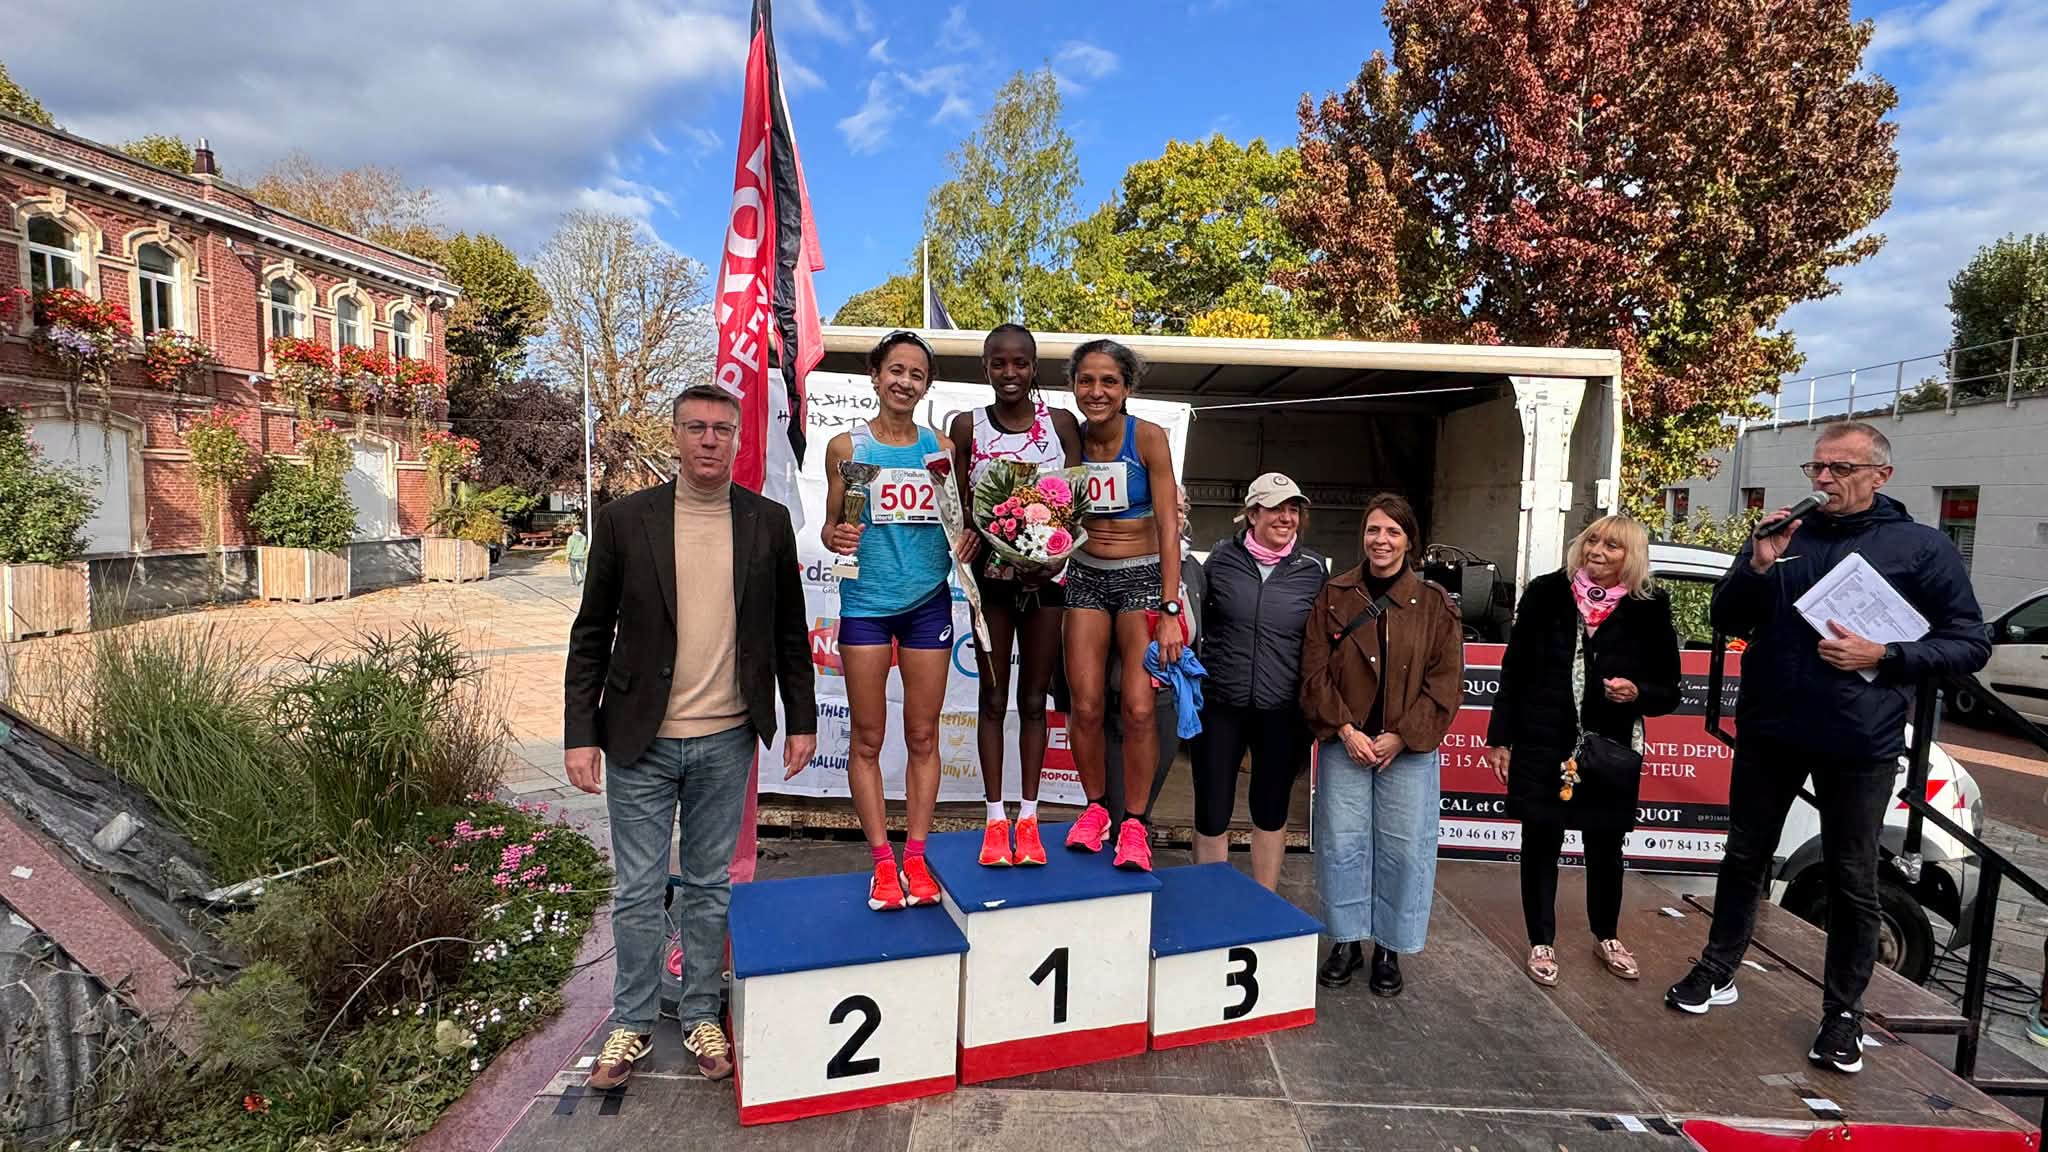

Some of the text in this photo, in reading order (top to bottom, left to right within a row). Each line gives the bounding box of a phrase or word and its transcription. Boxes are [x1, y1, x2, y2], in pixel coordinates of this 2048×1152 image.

[880, 484, 934, 511] 502
[1456, 754, 1471, 767] 15
[1476, 799, 1490, 812] et
[1449, 828, 1463, 839] 20
[1466, 828, 1480, 840] 46
[1484, 829, 1496, 840] 61
[1501, 830, 1515, 841] 87
[1659, 838, 1674, 850] 07
[1677, 839, 1692, 851] 84
[1696, 840, 1710, 852] 13
[1029, 947, 1069, 1024] 1
[1223, 947, 1259, 1020] 3
[826, 995, 882, 1080] 2
